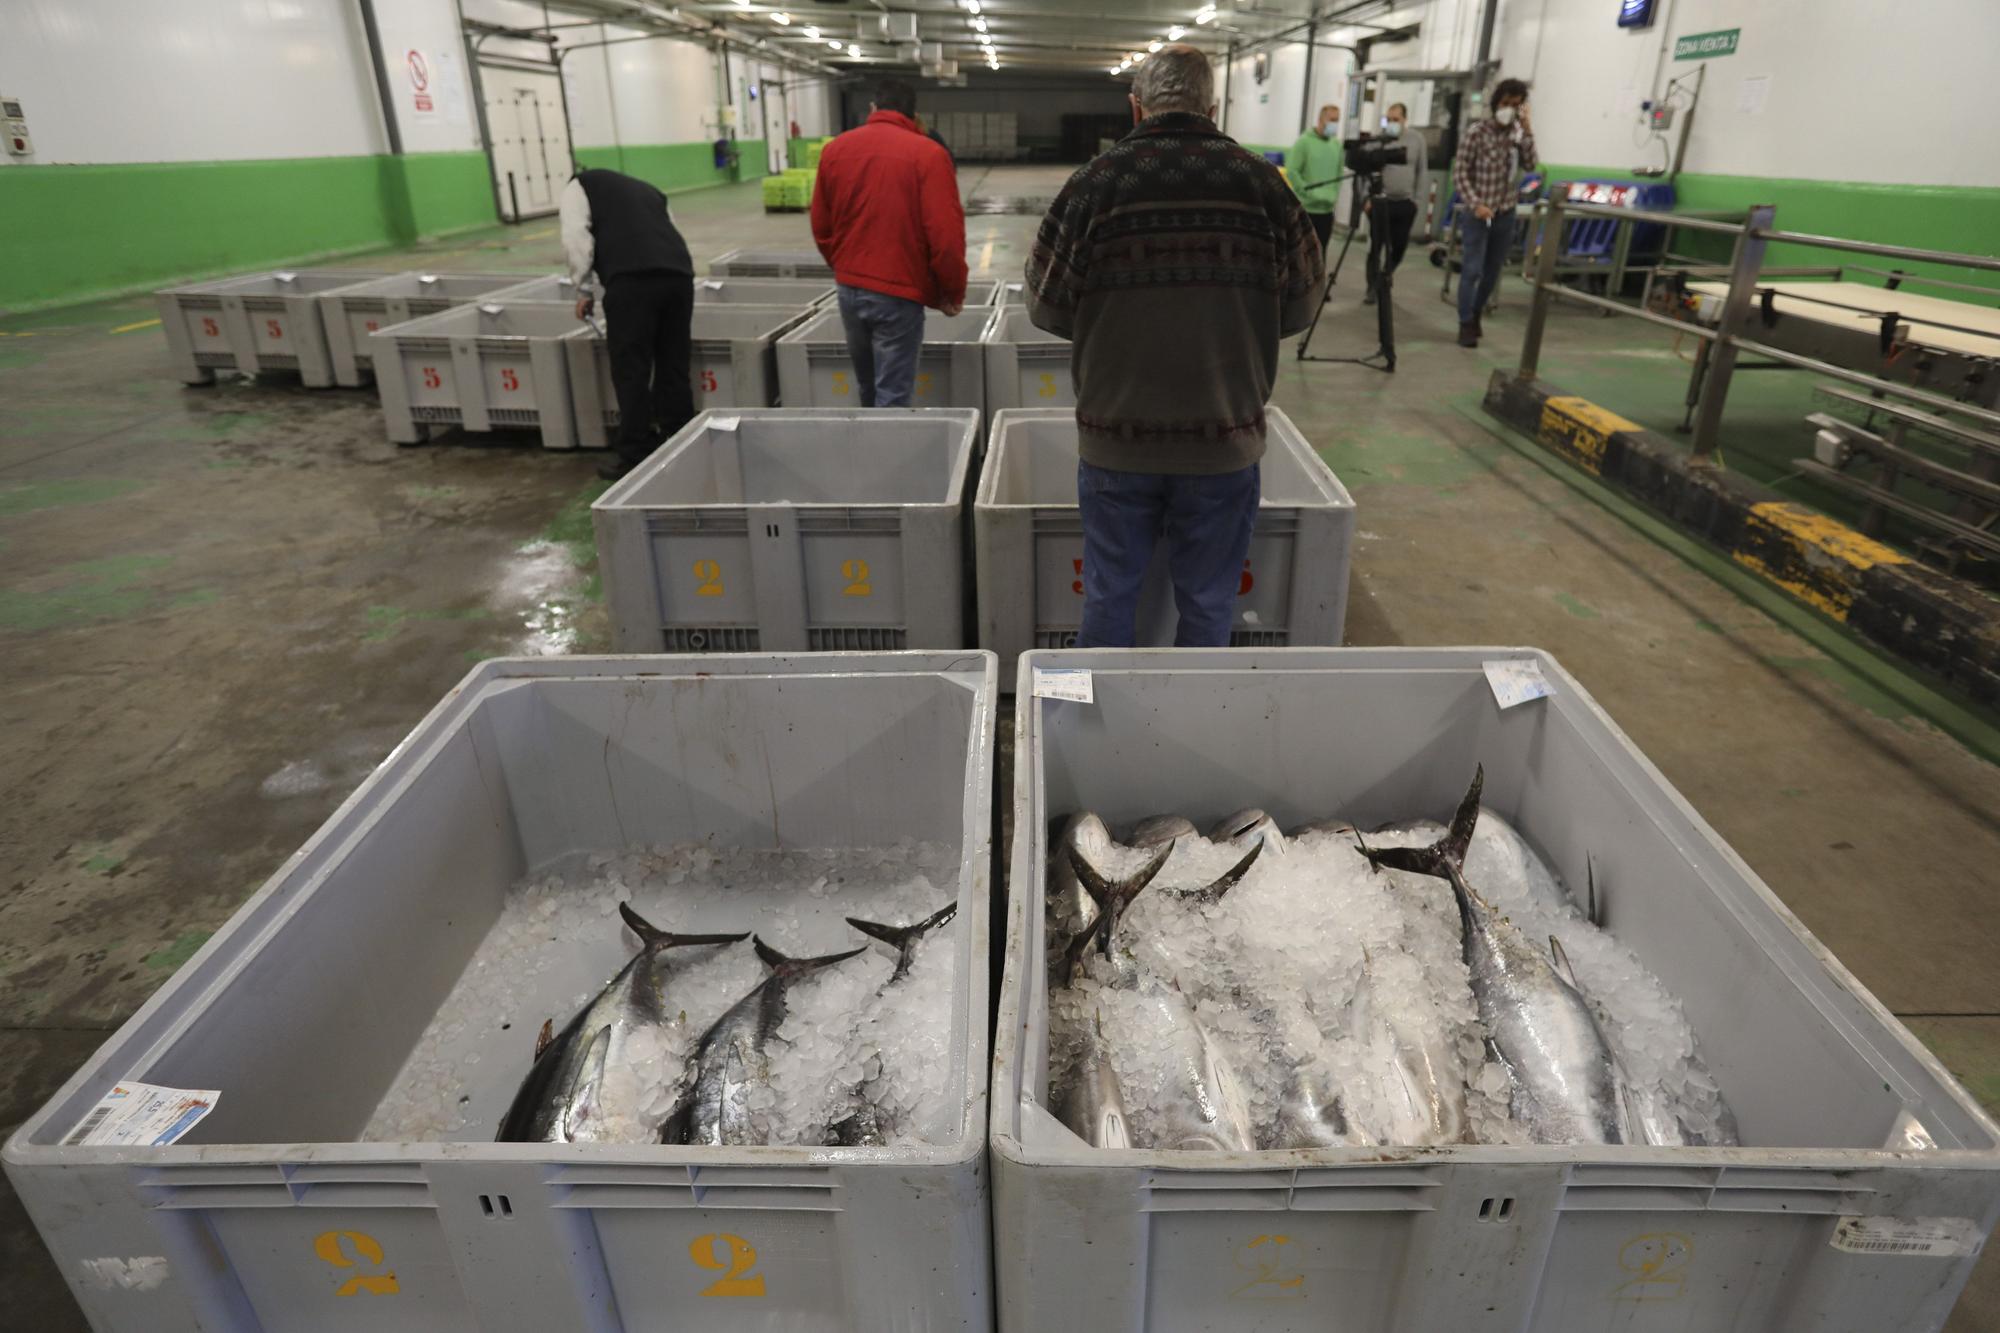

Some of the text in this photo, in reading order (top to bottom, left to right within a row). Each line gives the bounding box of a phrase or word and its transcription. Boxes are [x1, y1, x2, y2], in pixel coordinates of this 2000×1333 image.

[202, 318, 219, 337] 5
[267, 320, 283, 339] 5
[423, 367, 442, 389] 5
[502, 368, 520, 391] 5
[701, 370, 717, 392] 5
[693, 559, 725, 597] 2
[841, 559, 873, 597] 2
[312, 1231, 400, 1297] 2
[687, 1232, 767, 1297] 2
